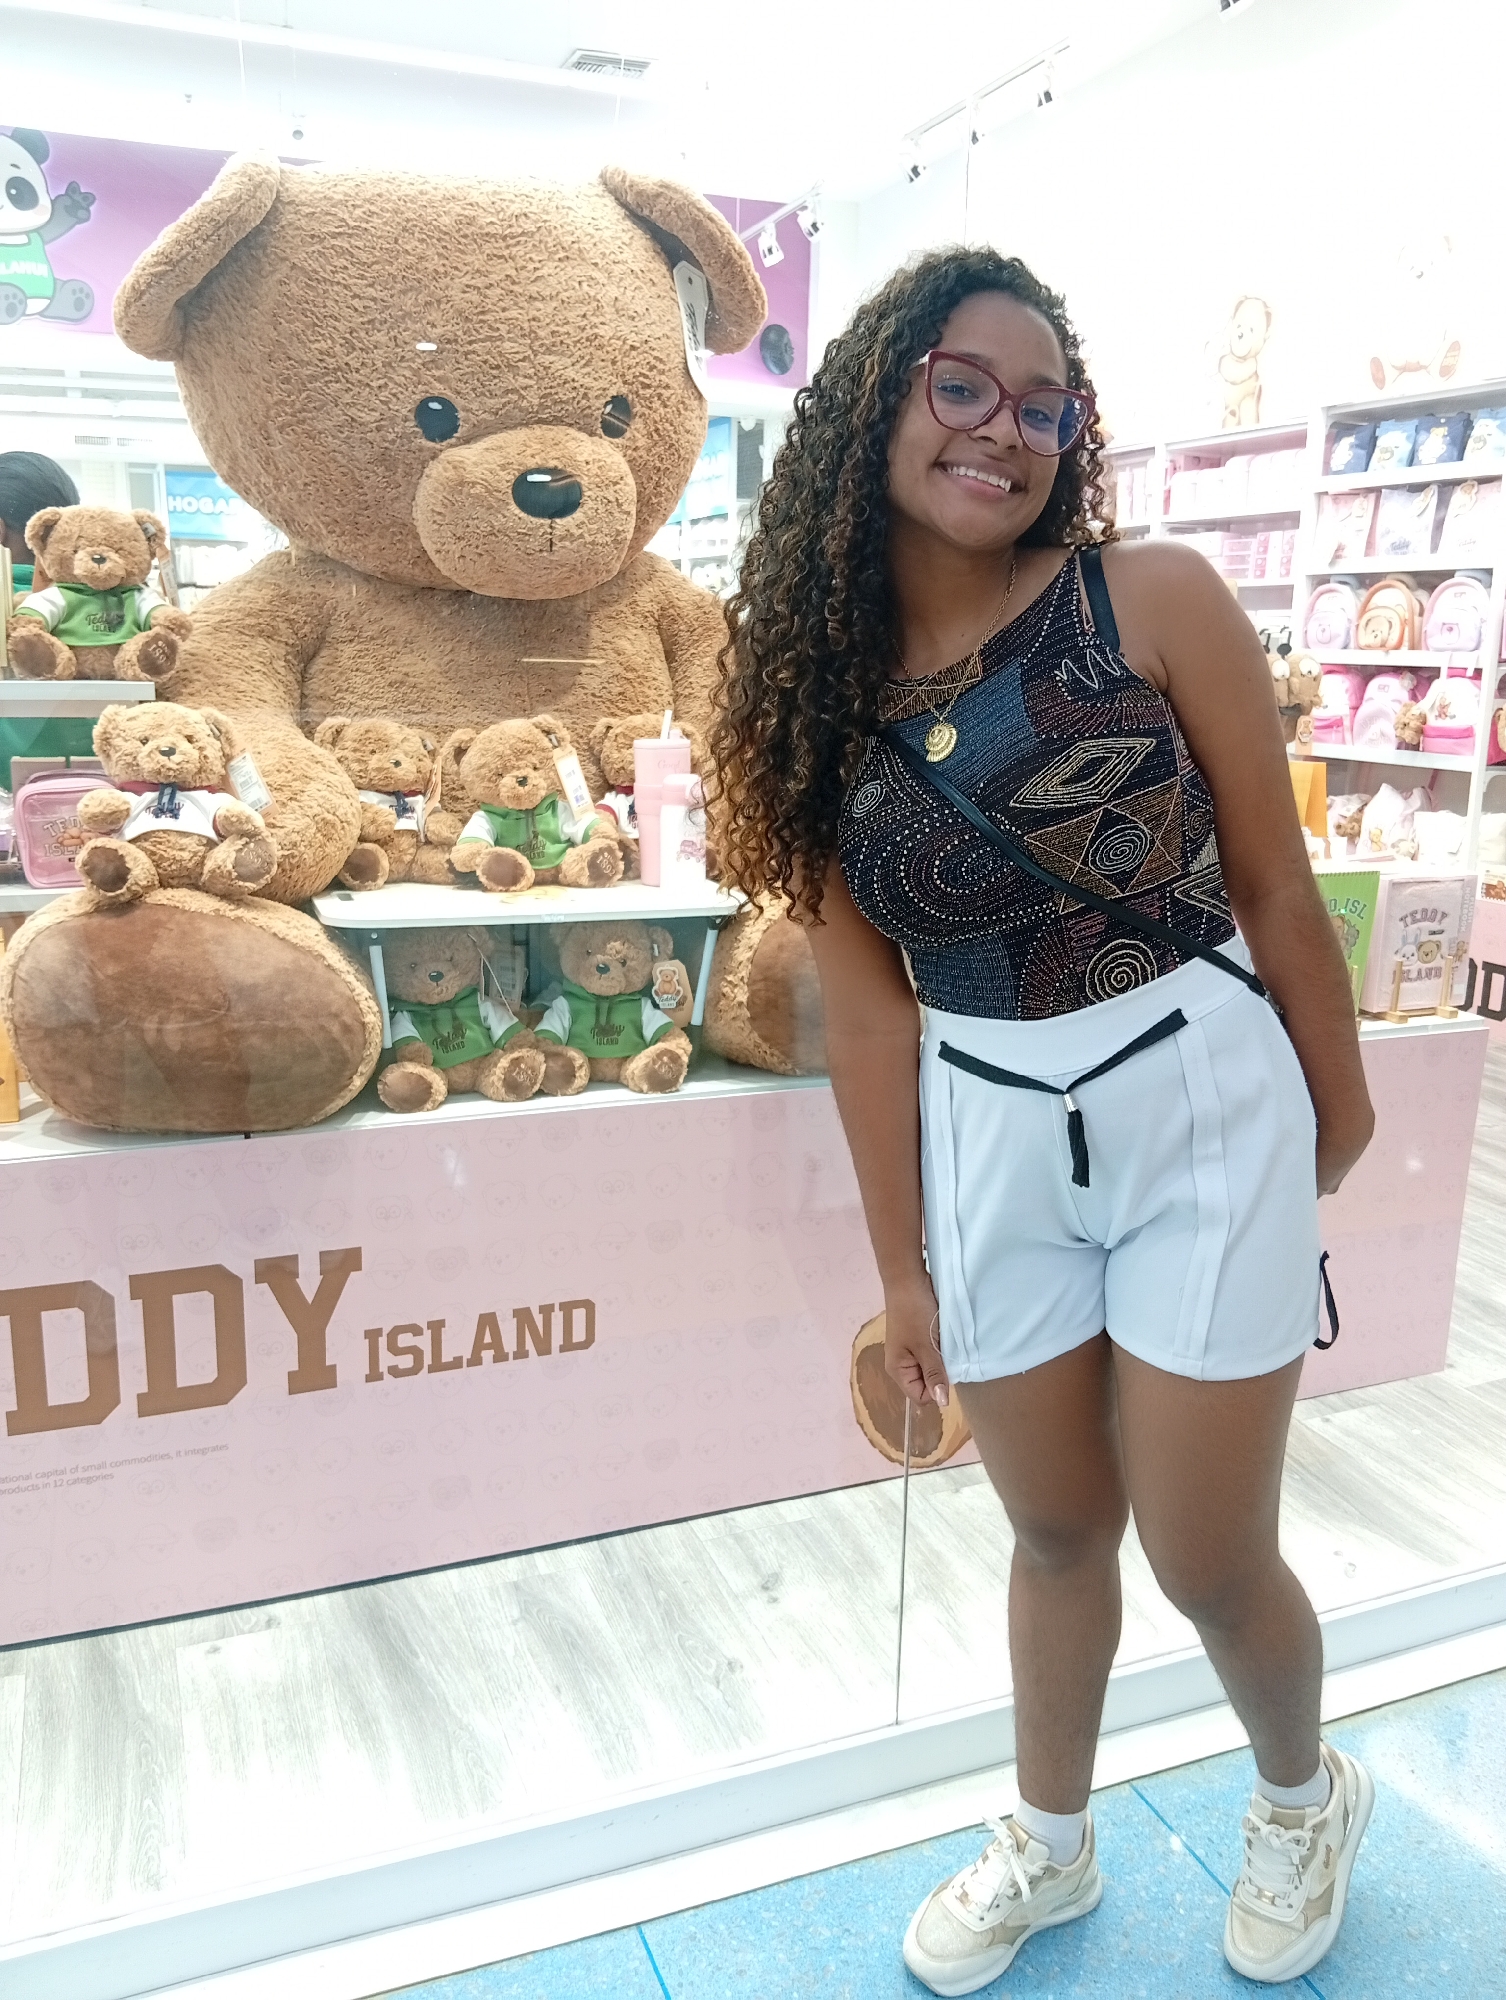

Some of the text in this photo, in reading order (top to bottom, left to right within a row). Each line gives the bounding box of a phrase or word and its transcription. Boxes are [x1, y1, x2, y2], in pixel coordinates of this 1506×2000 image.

[1398, 908, 1448, 928] TEDDY
[596, 1037, 619, 1046] ISLAND
[0, 1246, 595, 1437] DDY ISLAND
[35, 1466, 67, 1480] capital
[69, 1464, 80, 1474] of
[81, 1461, 107, 1473] small
[109, 1452, 174, 1468] commodities,
[175, 1449, 183, 1458] it
[184, 1443, 230, 1457] integrates
[42, 1481, 51, 1490] in
[53, 1477, 65, 1488] 12
[66, 1471, 115, 1487] categories
